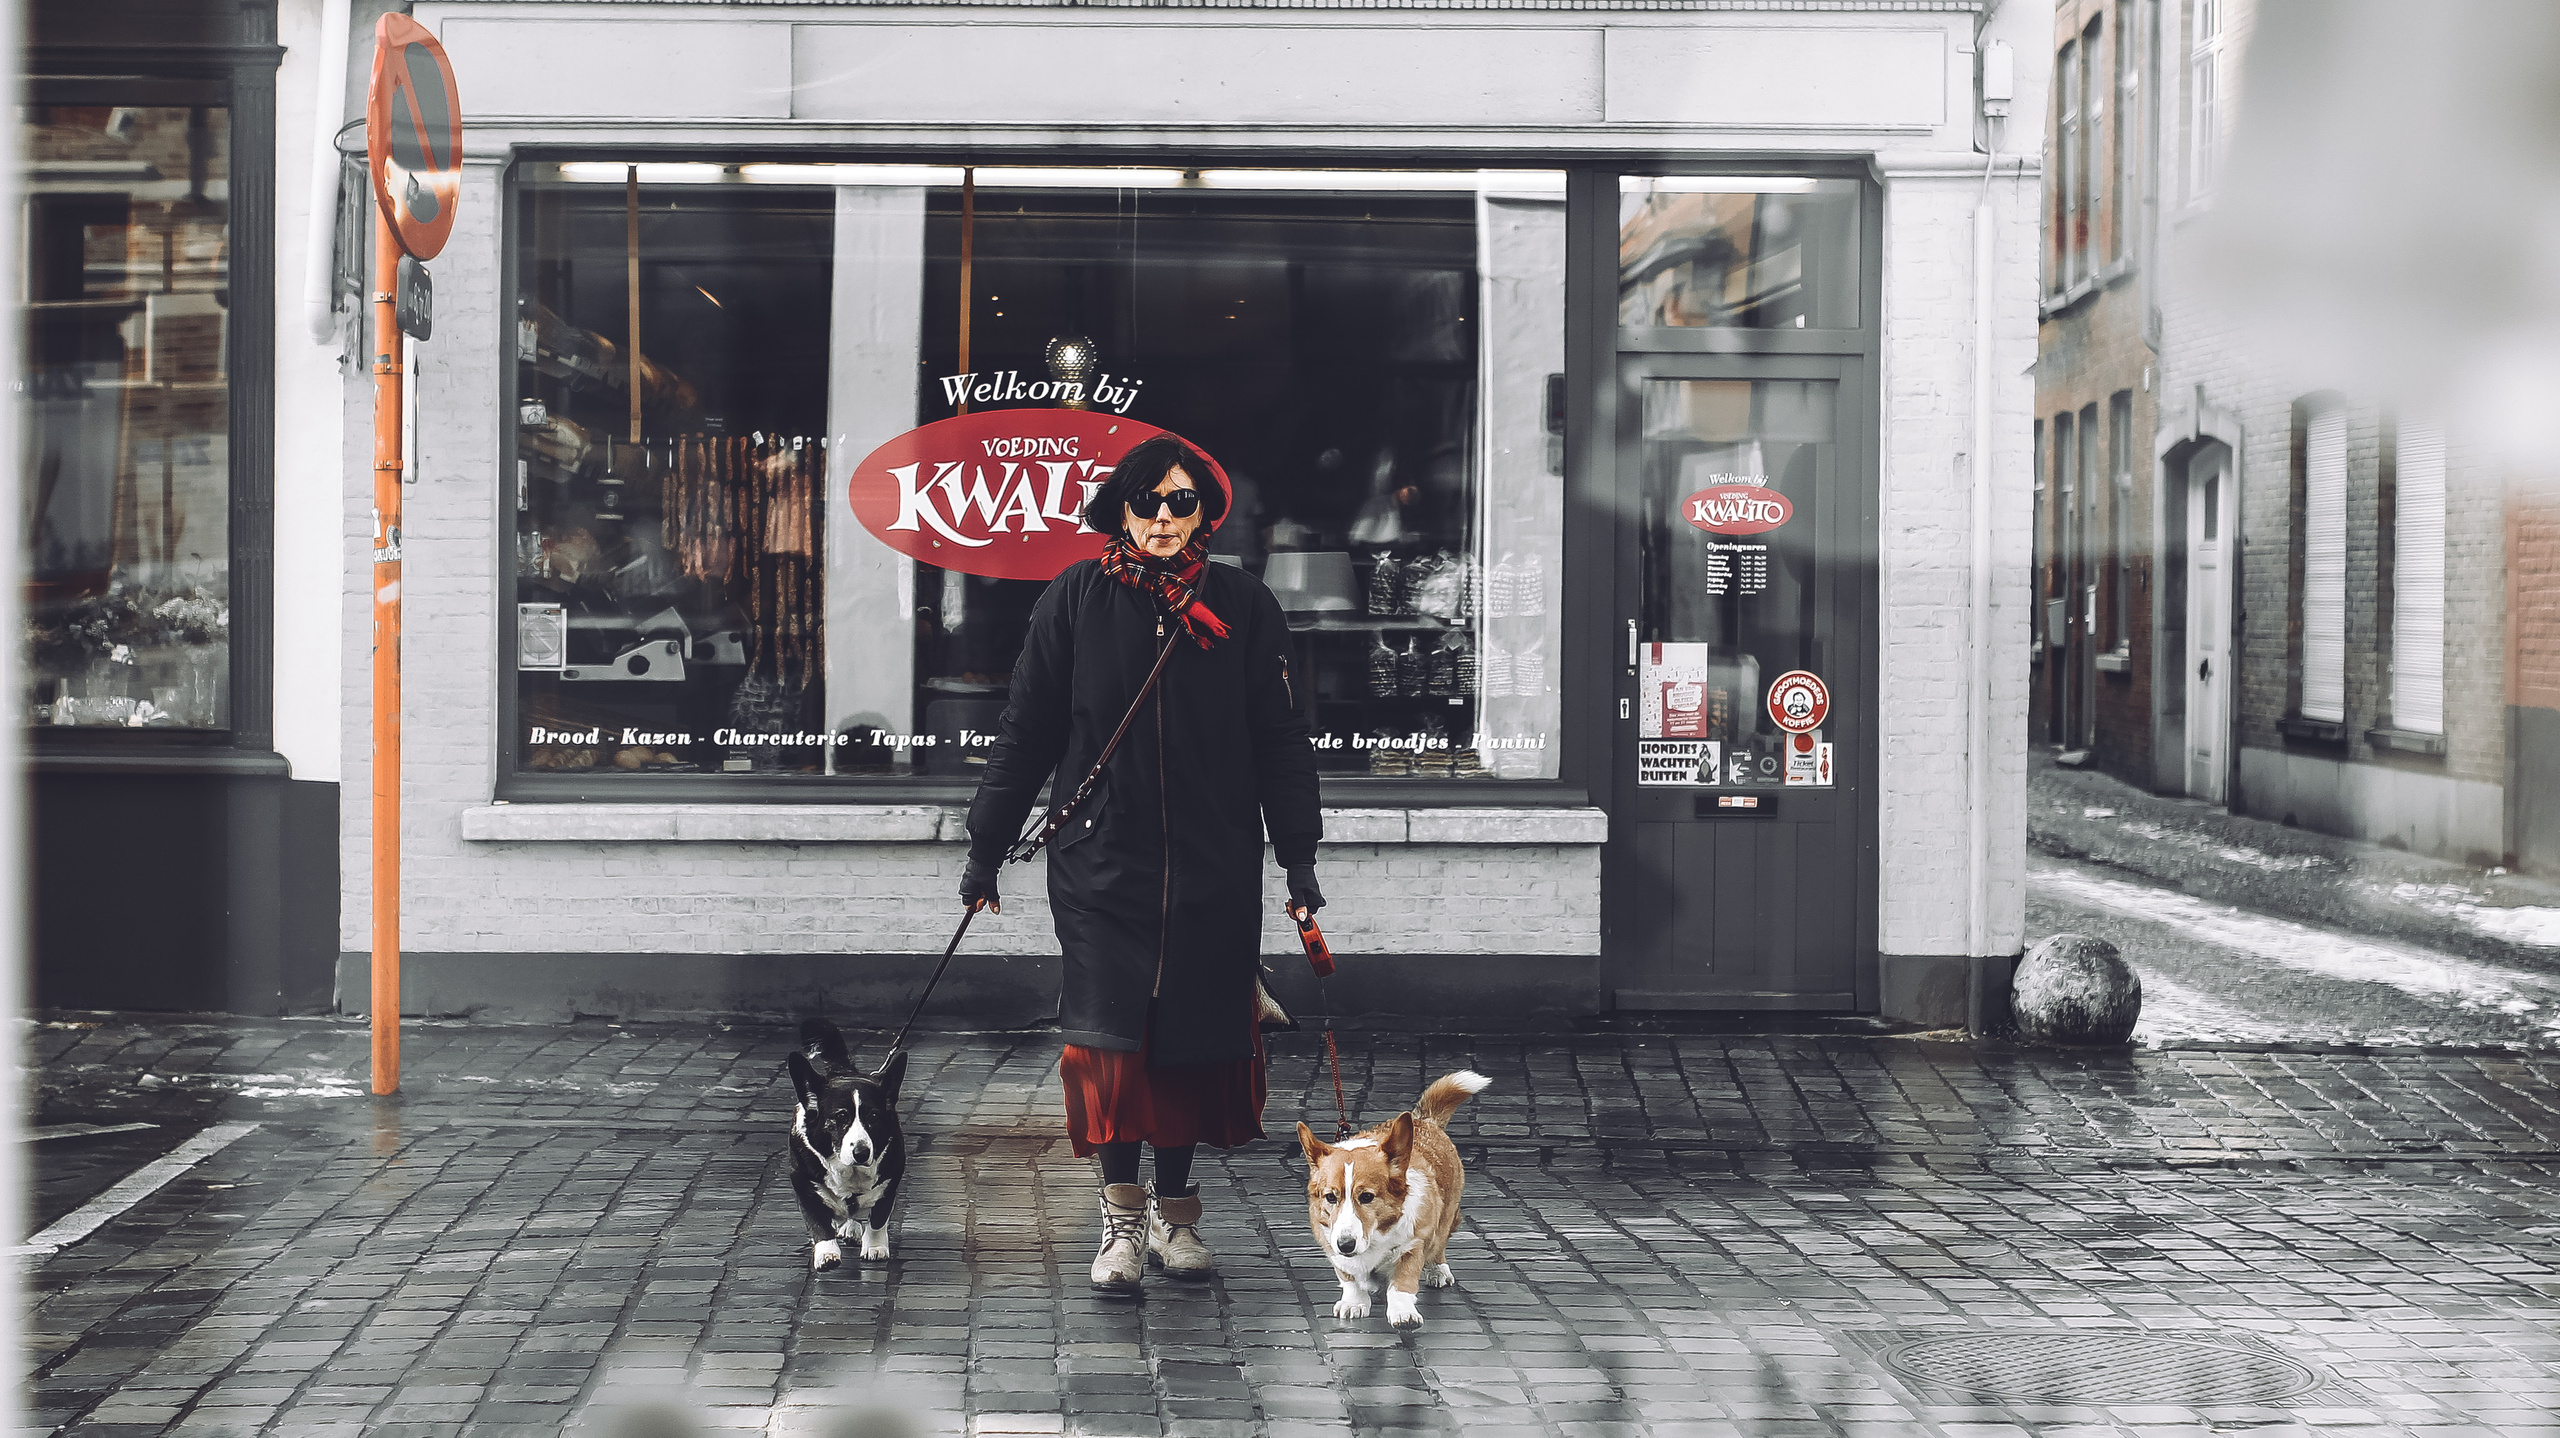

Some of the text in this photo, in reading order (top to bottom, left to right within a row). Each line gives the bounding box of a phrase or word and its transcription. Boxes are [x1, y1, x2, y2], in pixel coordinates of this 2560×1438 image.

[939, 370, 1143, 414] Welkom bij
[980, 436, 1080, 457] VOEDING
[1708, 473, 1769, 487] Welkom bij
[1706, 542, 1767, 553] Openingsuren
[1773, 676, 1824, 705] GROOTMOEDERS
[1782, 715, 1815, 728] KOFFIE
[529, 726, 600, 745] Brood
[620, 727, 692, 745] Kazen
[713, 728, 849, 746] Charcuterie
[870, 729, 937, 752] Tapas
[1352, 732, 1449, 754] broodjes
[1470, 732, 1547, 749] Panini
[1641, 743, 1698, 755] HONDJES
[1640, 757, 1700, 768] WACHTEN
[1641, 771, 1687, 781] BUITEN
